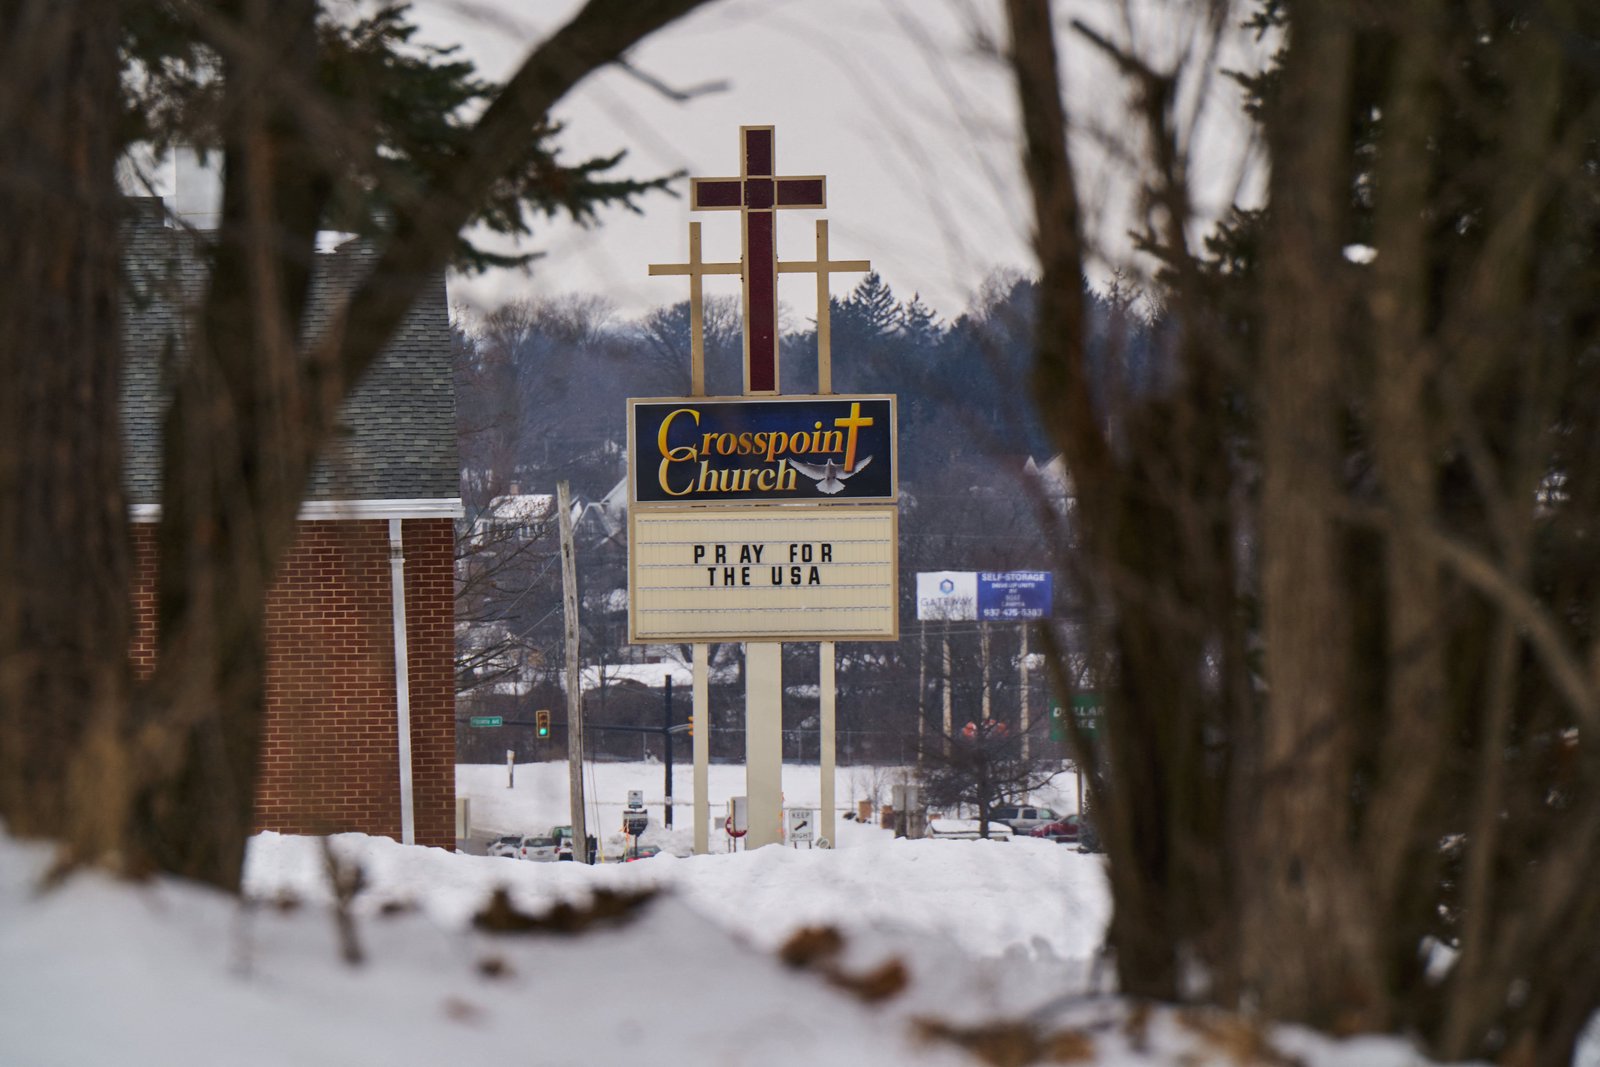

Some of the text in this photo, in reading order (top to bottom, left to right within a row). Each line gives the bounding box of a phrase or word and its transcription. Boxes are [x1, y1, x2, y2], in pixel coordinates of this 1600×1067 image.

[657, 402, 874, 472] Crosspoint
[658, 446, 797, 496] Church
[694, 543, 833, 564] PRAY FOR
[707, 566, 821, 586] THE USA
[982, 573, 1045, 581] SELF-STORAGE
